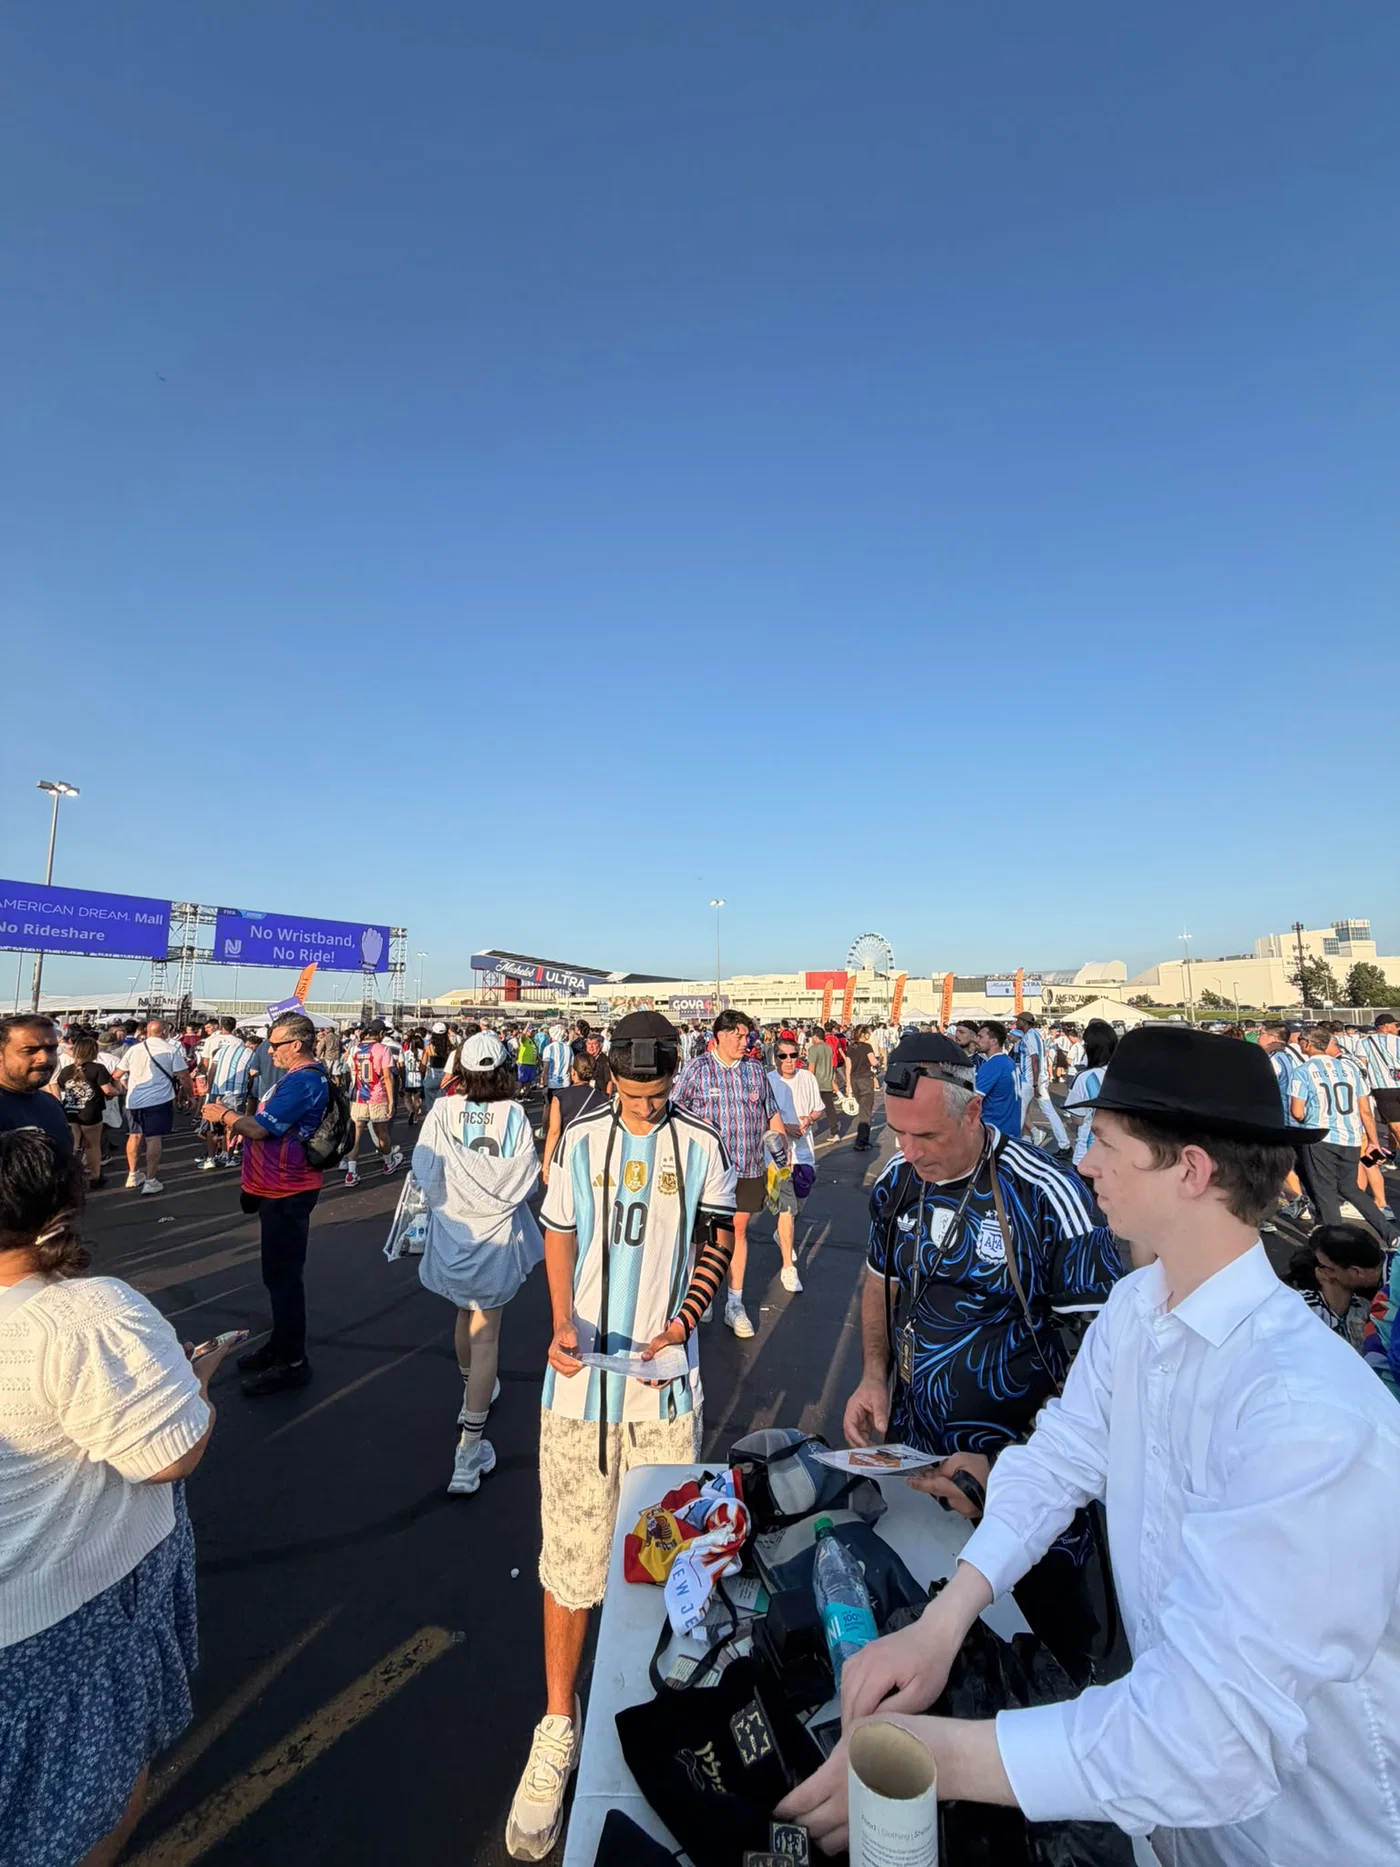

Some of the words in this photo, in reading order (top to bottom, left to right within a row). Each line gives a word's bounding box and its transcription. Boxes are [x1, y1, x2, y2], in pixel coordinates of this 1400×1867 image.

[135, 912, 164, 925] Mall
[23, 923, 105, 941] Rideshare
[250, 925, 273, 940] No
[277, 928, 356, 948] Wristband,
[273, 946, 295, 960] No
[299, 949, 335, 963] Ride!
[495, 960, 536, 977] Michelob
[545, 971, 586, 990] ULTRA
[1319, 1081, 1354, 1116] 10
[458, 1110, 495, 1125] MESSI
[613, 1200, 649, 1247] 10
